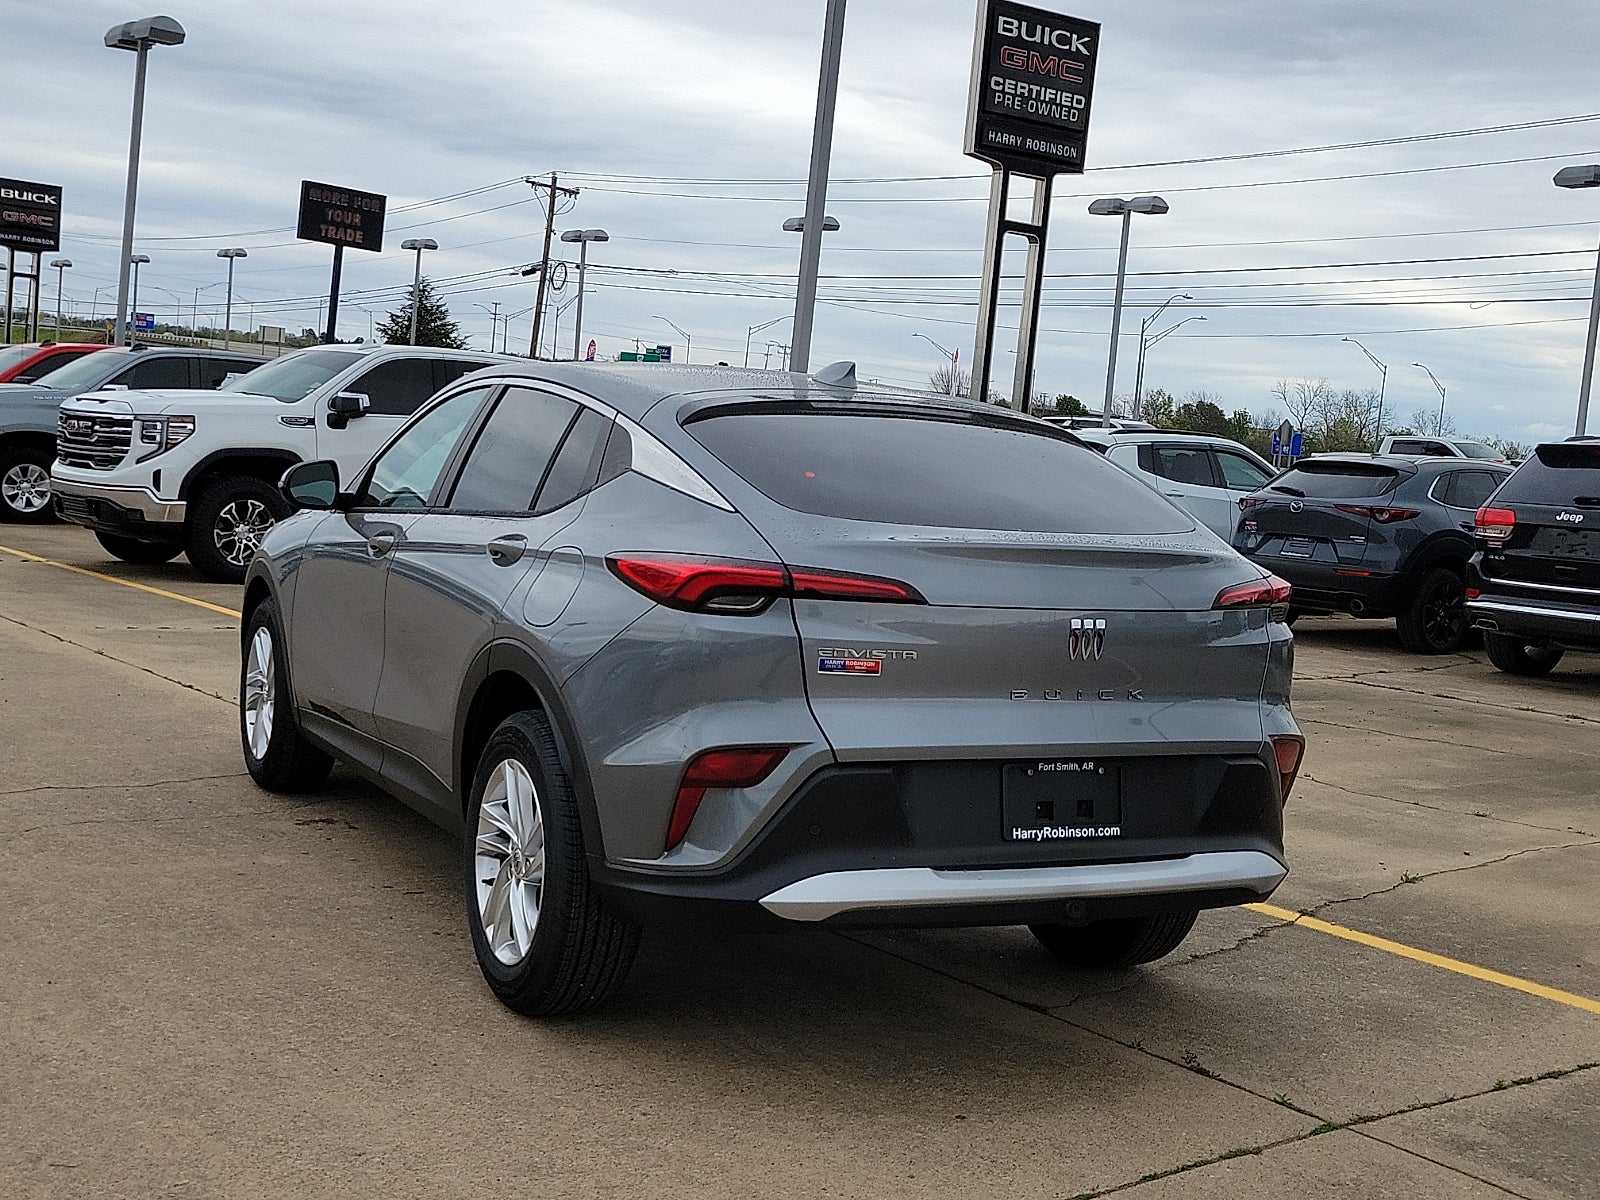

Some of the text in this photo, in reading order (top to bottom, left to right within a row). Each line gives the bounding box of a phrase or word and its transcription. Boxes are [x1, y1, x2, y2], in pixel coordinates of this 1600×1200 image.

[997, 15, 1092, 56] BUICK
[1000, 45, 1085, 83] GMC
[990, 76, 1086, 109] CERTIFIED
[994, 92, 1079, 122] PRE-OWNED
[988, 130, 1078, 158] HARRY ROBINSON
[0, 187, 58, 205] BUICK
[2, 210, 54, 227] GMC
[320, 224, 364, 244] TRADE
[1555, 511, 1584, 524] Jeep
[818, 647, 918, 660] ENVISTA
[845, 660, 876, 668] ROBINSON
[1010, 689, 1144, 701] BUICK
[1038, 761, 1094, 772] Fort Smith, AR
[1012, 826, 1121, 842] HarryRobinson.com
